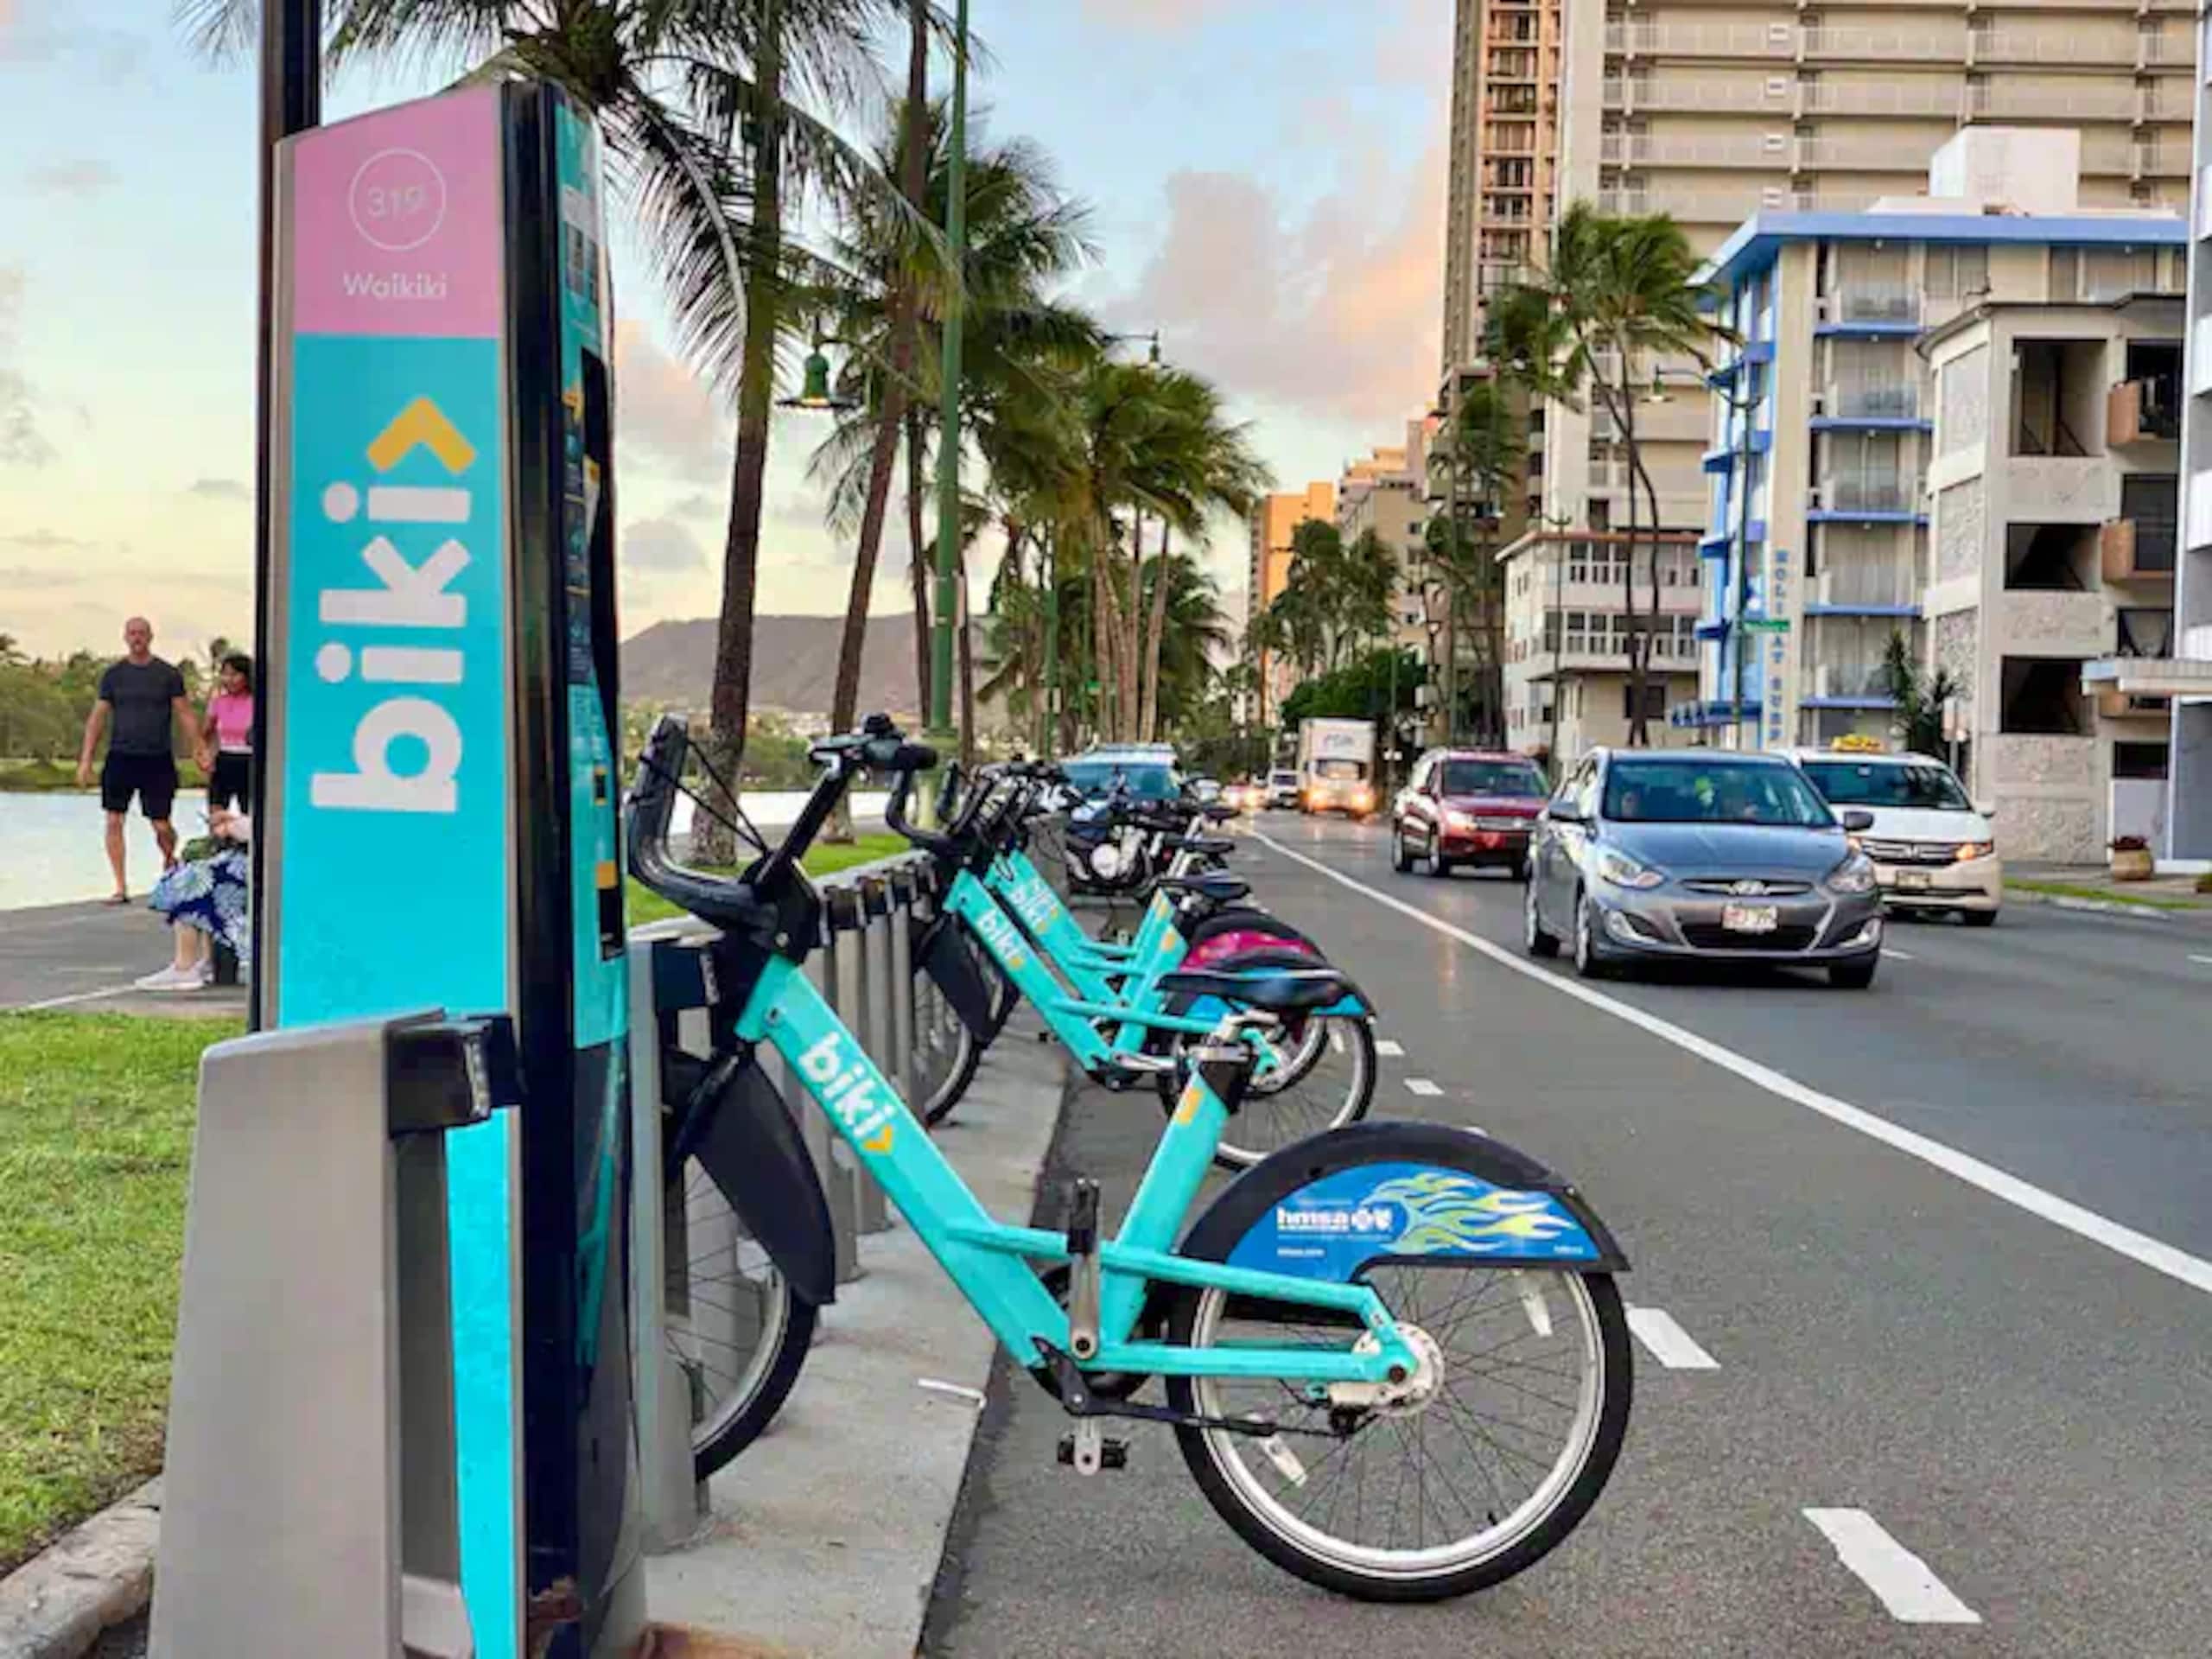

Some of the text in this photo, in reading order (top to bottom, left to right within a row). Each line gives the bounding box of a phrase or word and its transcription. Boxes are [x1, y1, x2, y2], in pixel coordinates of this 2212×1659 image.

[366, 185, 427, 219] 319
[343, 271, 448, 302] Waikiki
[309, 480, 472, 813] biki
[1770, 550, 1789, 664] HOLIAY
[798, 1031, 895, 1138] biki
